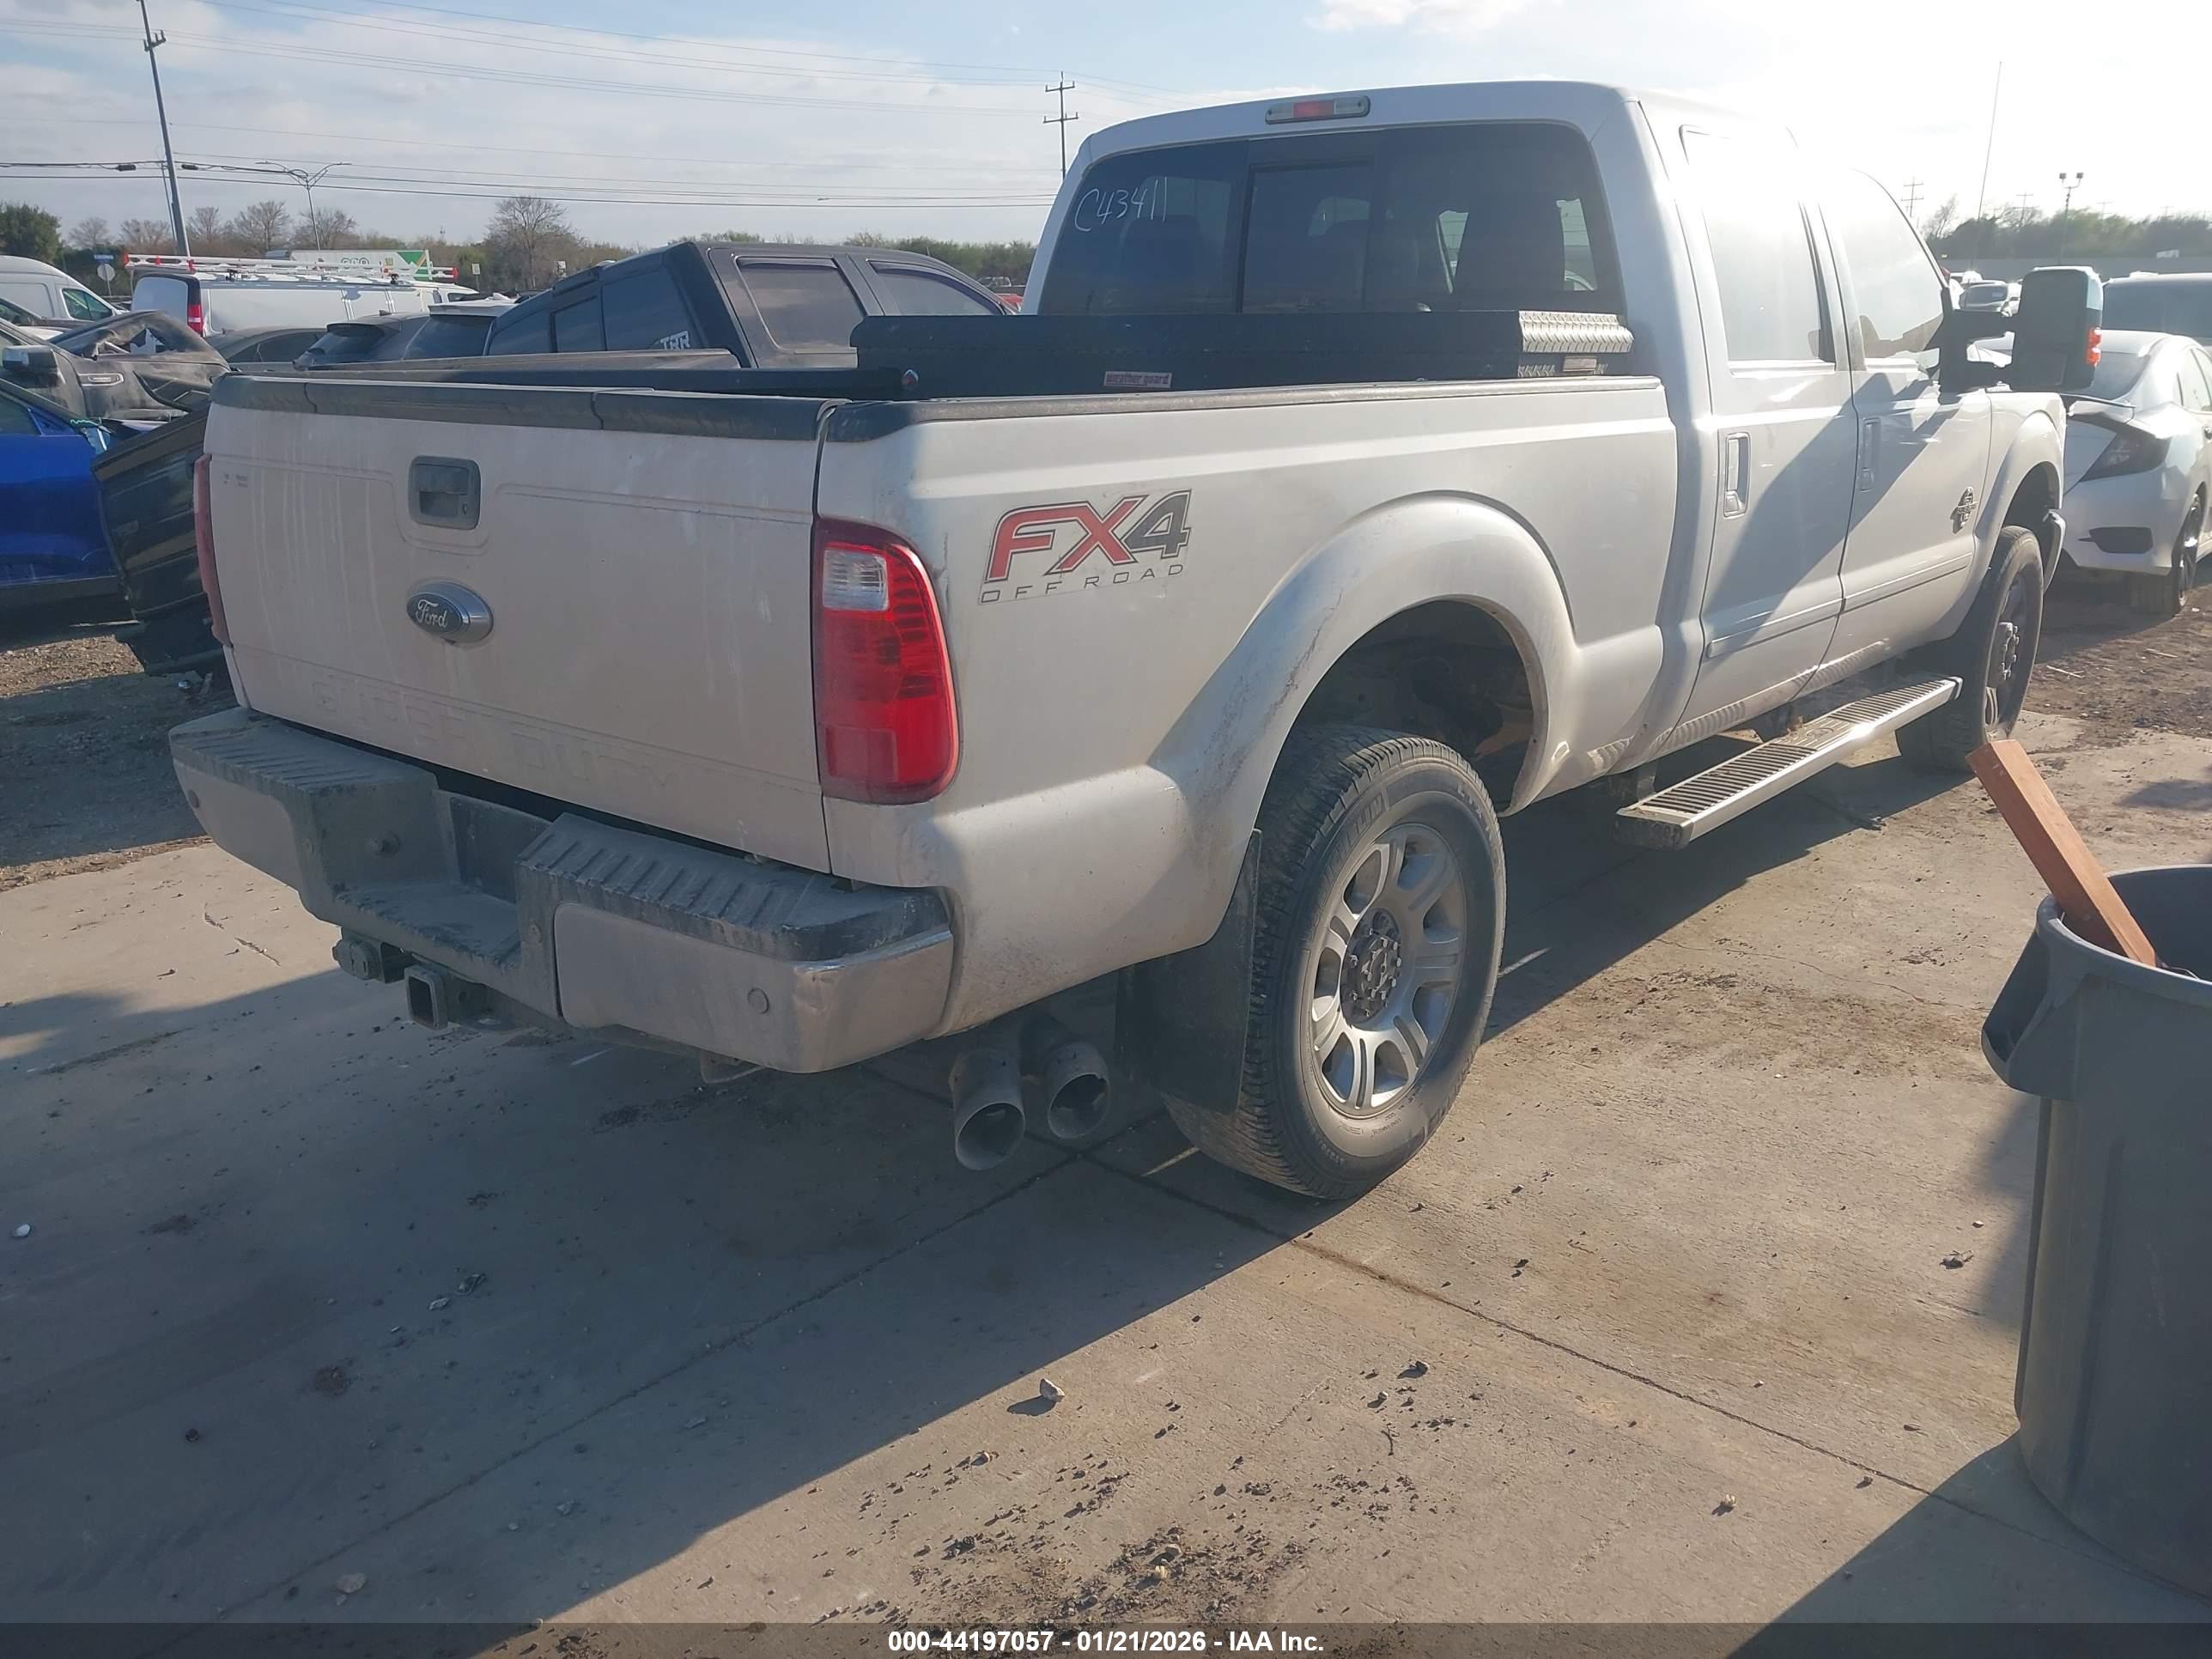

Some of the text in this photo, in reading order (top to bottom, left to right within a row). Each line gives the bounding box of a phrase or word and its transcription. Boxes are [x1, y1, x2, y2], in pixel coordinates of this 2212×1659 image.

[1074, 176, 1168, 232] C43411
[983, 489, 1192, 584] FX4
[981, 564, 1183, 603] OFF ROAD
[416, 599, 448, 628] Ford
